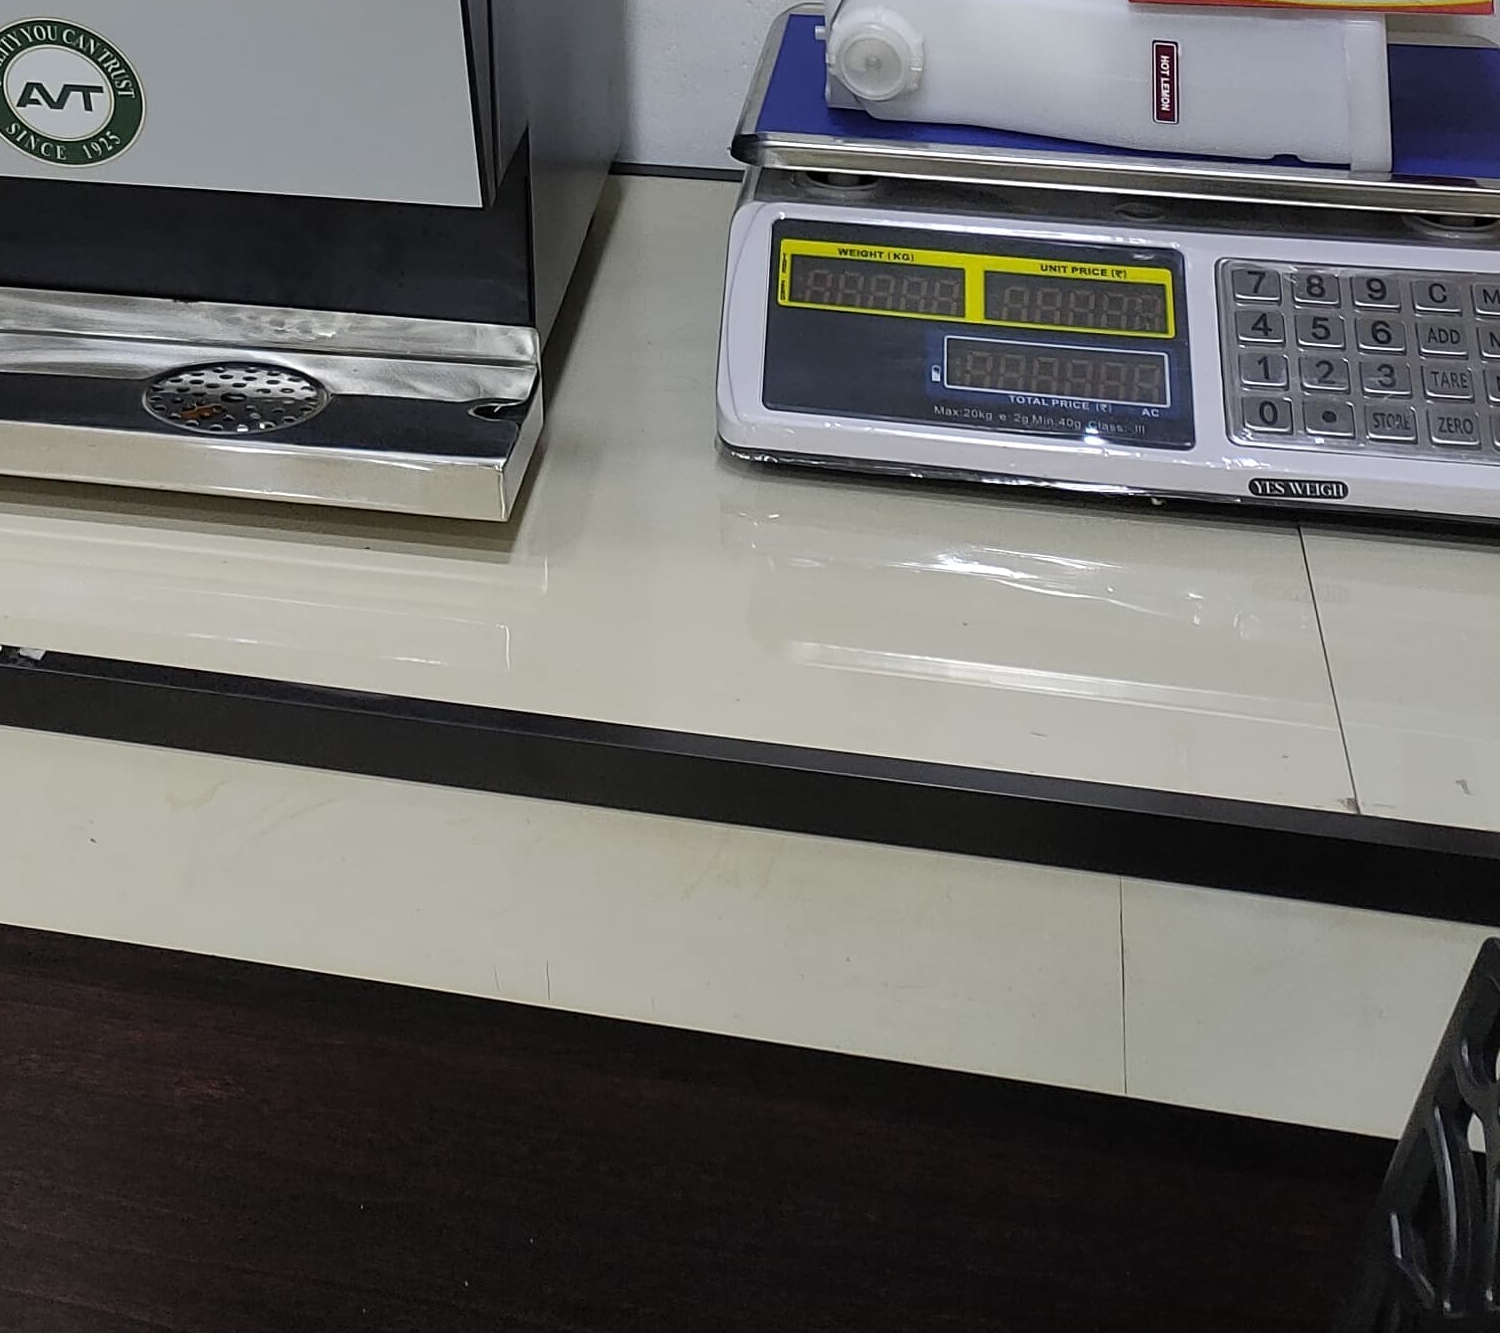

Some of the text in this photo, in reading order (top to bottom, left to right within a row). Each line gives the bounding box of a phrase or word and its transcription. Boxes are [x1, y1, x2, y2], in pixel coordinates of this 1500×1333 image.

[19, 25, 58, 43] YOU
[62, 28, 100, 55] CAN
[97, 48, 135, 99] TRUST
[16, 81, 104, 112] AVT
[1160, 55, 1171, 112] HOT LEMON
[6, 122, 121, 161] SINCE 1925
[838, 247, 884, 260] WEIGHT
[1040, 264, 1068, 274] UNIT
[1071, 266, 1108, 277] PRICE
[1247, 271, 1266, 294] 7
[1306, 274, 1326, 299] 8
[1367, 278, 1387, 301] 9
[1428, 283, 1447, 304] C
[1251, 312, 1461, 345] 4 5 6 ADD
[1257, 356, 1468, 389] 1 2 3 TARE
[1009, 395, 1049, 406] TOTAL
[1051, 398, 1090, 410] PRICE
[1142, 408, 1160, 417] AC
[1258, 400, 1278, 426] 0
[1438, 417, 1474, 434] ZERO
[1253, 480, 1344, 497] YES WEIGH
